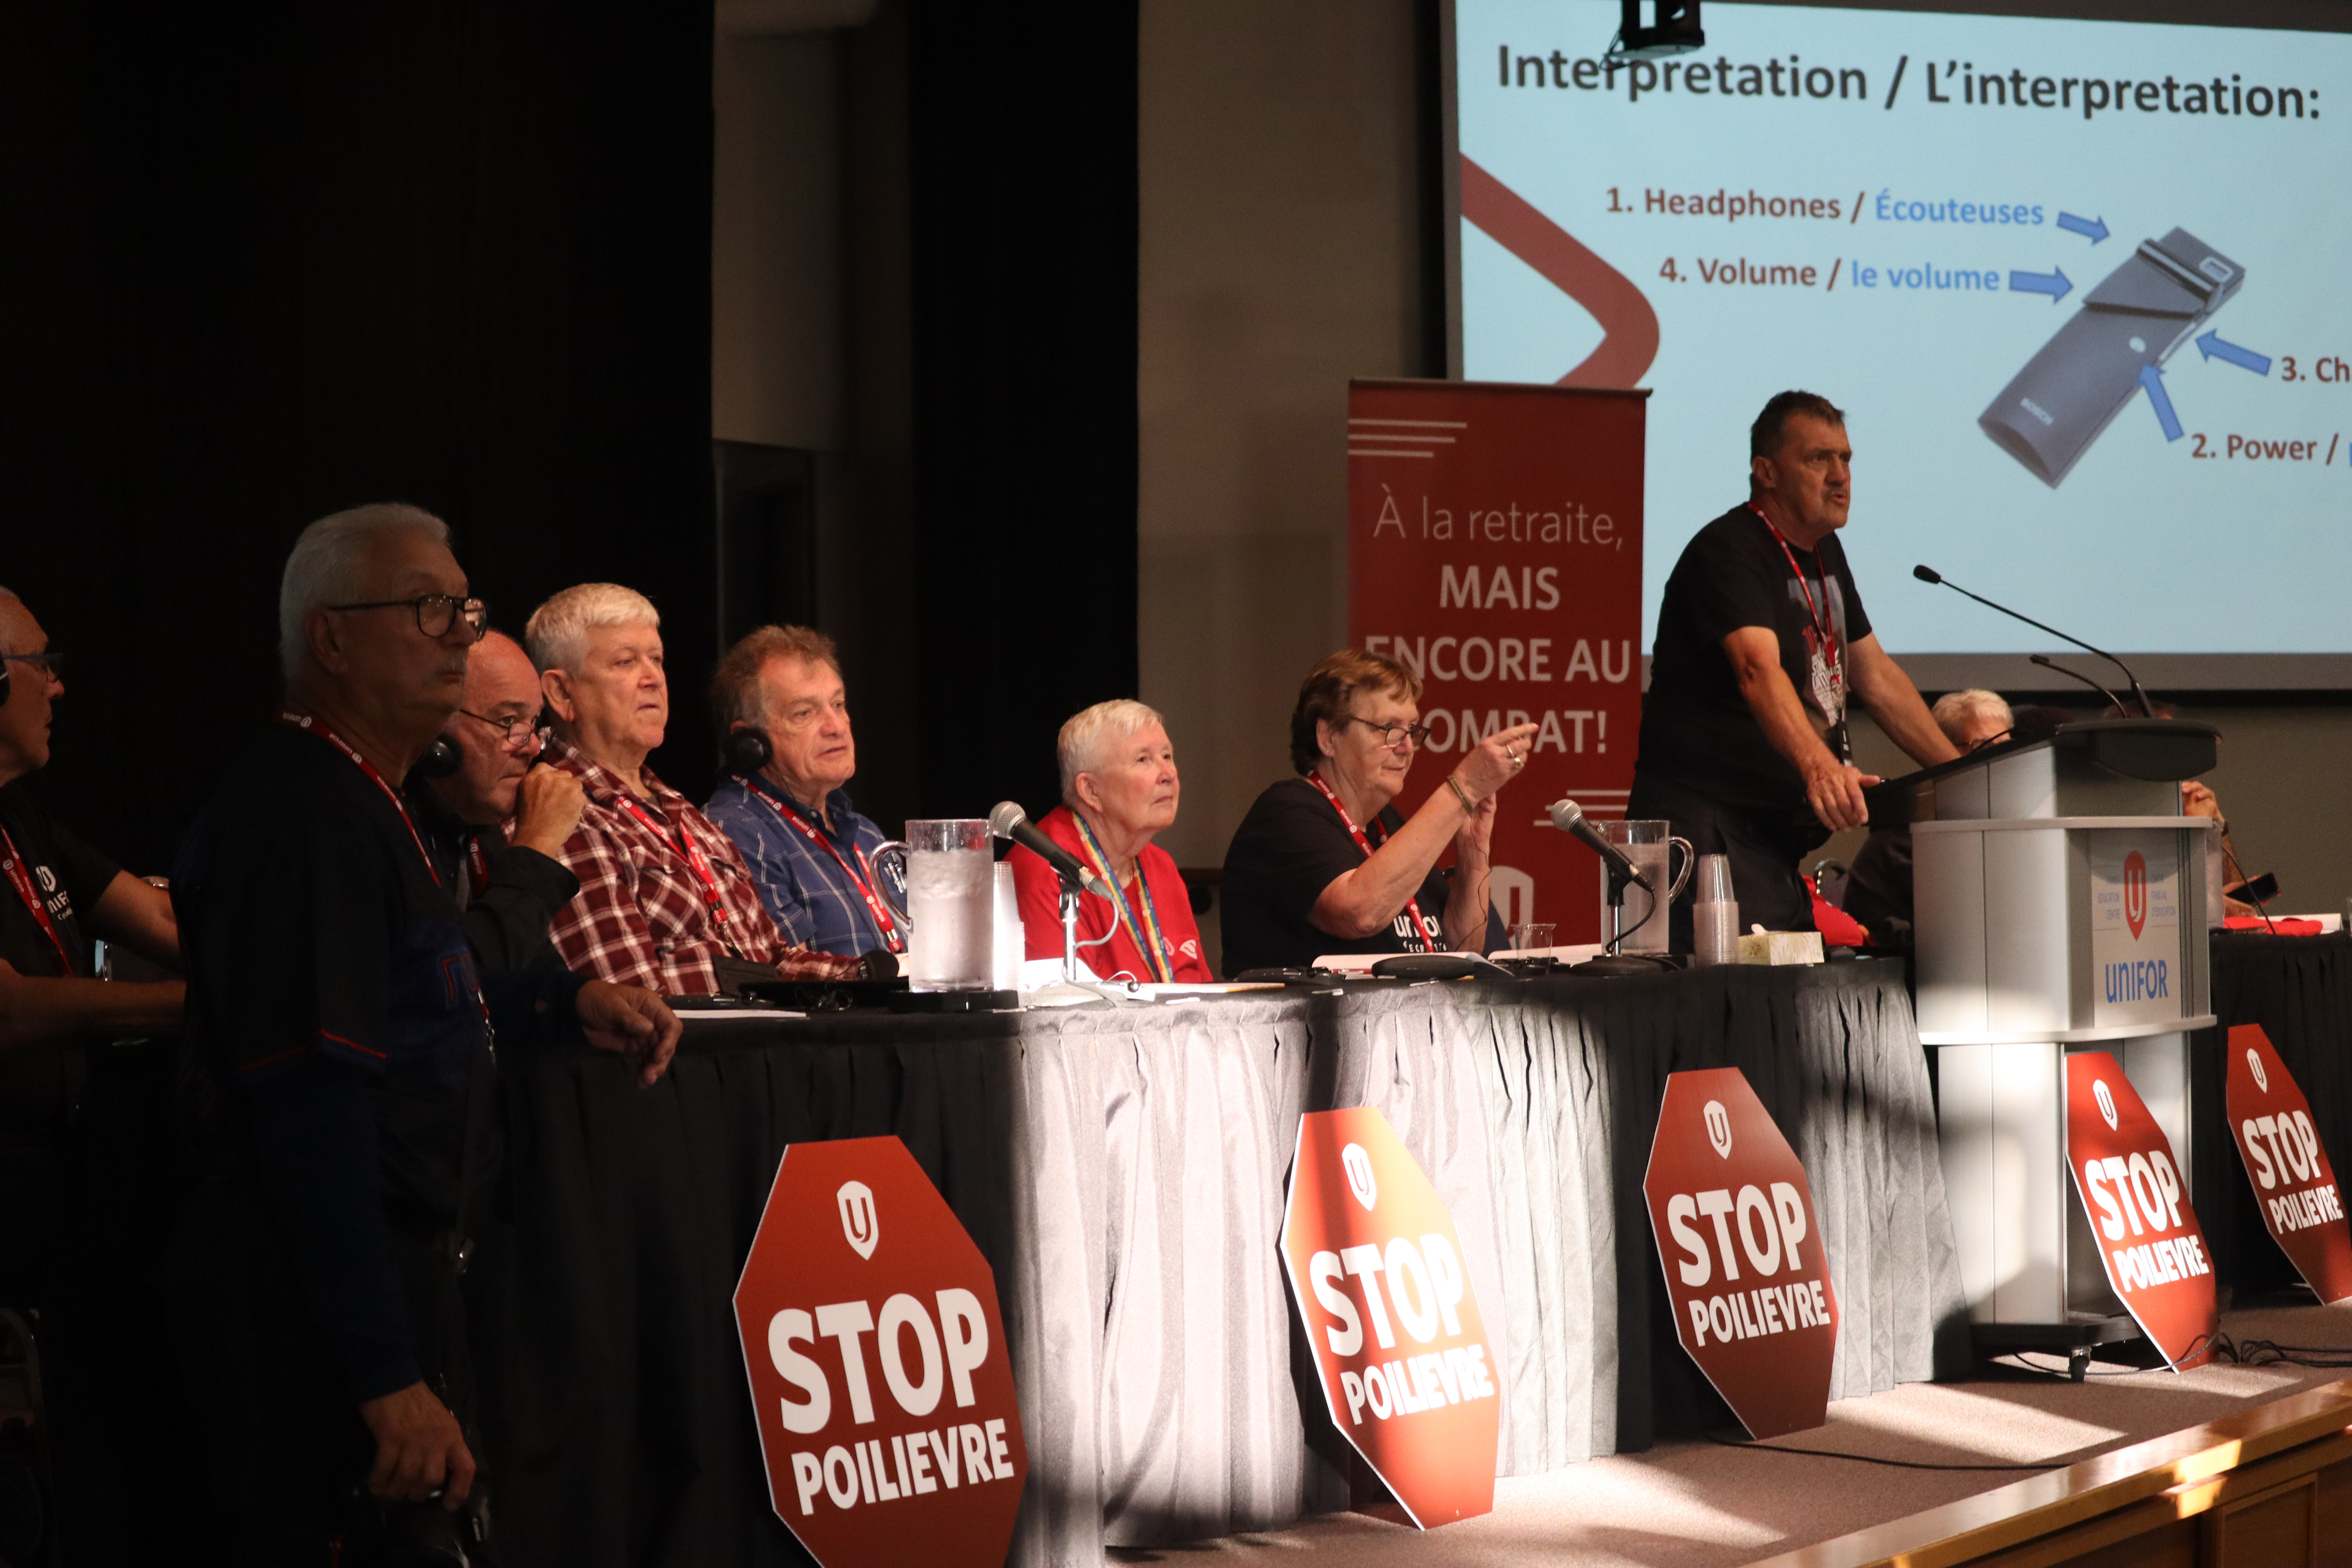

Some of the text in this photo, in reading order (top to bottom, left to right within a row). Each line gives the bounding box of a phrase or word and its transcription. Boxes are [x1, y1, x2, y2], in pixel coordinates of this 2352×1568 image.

[1499, 45, 2320, 119] Interpretation / L’interpretation:
[1606, 187, 2044, 225] 1. Headphones / Écouteuses
[1659, 257, 2000, 292] 4. Volume / le volume
[2281, 356, 2351, 383] 3. Ch
[2192, 433, 2217, 459] 2.
[2227, 434, 2318, 461] Power
[2325, 433, 2339, 466] /
[1373, 483, 1622, 551] À la retraite,
[1439, 565, 1560, 611] MAIS
[1564, 639, 1630, 684] AU
[1422, 708, 1606, 754] OMAT!
[2242, 1109, 2319, 1190] STOP
[2085, 1150, 2180, 1241] STOP
[2267, 1184, 2344, 1234] POILIEVRE
[1667, 1181, 1807, 1287] STOP
[2112, 1234, 2210, 1292] POILIEVRE
[1309, 1233, 1463, 1357] STOP
[1688, 1280, 1830, 1347] POILIEVRE
[768, 1287, 989, 1434] STOP
[1340, 1344, 1494, 1425] POILIEVRE
[791, 1418, 1014, 1516] POILIEVRE
